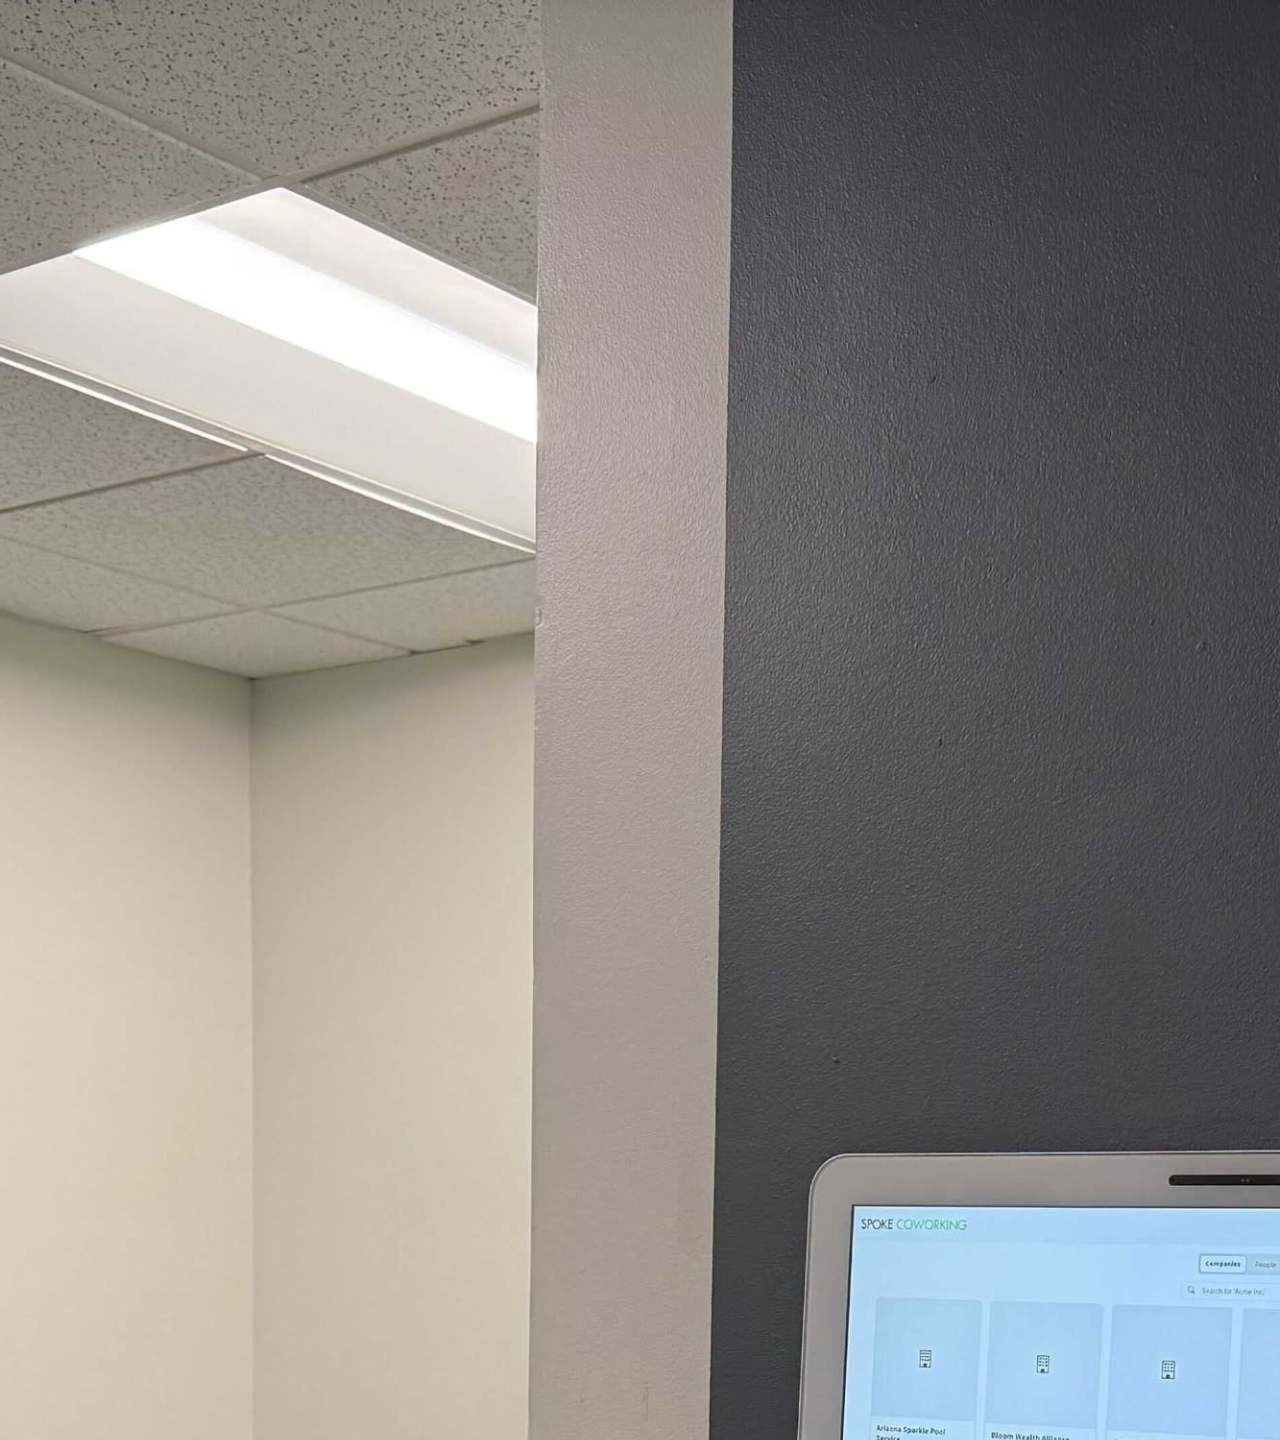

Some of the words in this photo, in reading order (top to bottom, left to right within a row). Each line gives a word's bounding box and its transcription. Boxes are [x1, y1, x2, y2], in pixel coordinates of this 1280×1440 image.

[861, 1218, 894, 1230] SPOKE
[896, 1219, 968, 1231] COWORKING
[903, 1426, 929, 1434] Sparkle
[991, 1431, 1014, 1440] Bloom
